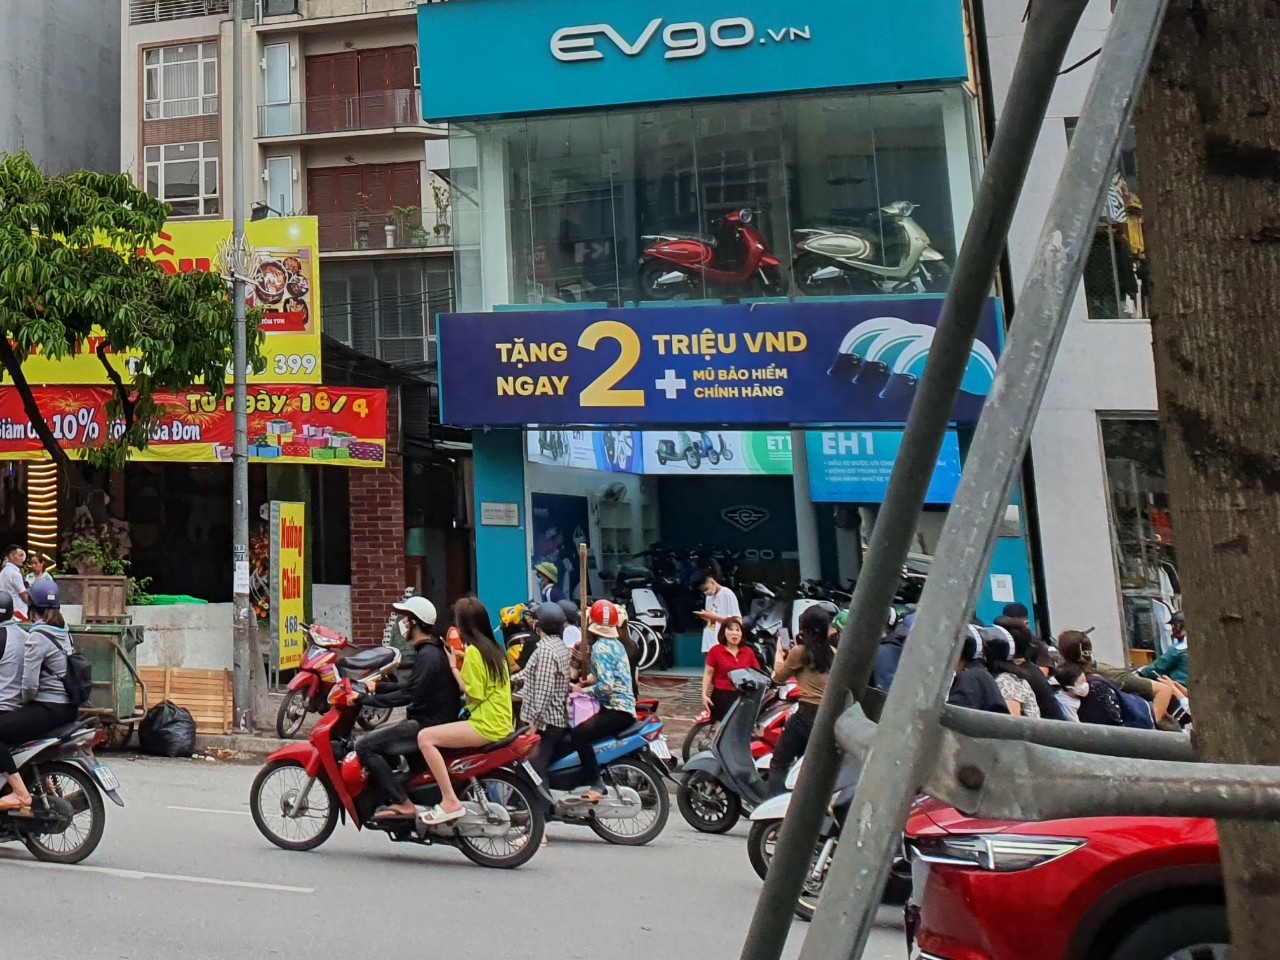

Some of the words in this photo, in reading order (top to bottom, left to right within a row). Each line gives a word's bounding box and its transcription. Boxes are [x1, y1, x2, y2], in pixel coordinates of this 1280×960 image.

[496, 337, 568, 368] TẶNG
[652, 327, 737, 361] TRIỆU
[743, 330, 808, 354] VND
[273, 353, 317, 375] 399
[577, 320, 646, 407] 2
[693, 367, 715, 381] MŨ
[718, 365, 749, 381] BẢO
[751, 363, 788, 380] HIỂM
[496, 375, 570, 396] NGAY
[693, 383, 739, 399] CHÍNH
[741, 383, 784, 398] HÃNG
[52, 407, 99, 443] 10%
[172, 420, 201, 441] Đơn
[822, 431, 875, 456] EH1
[284, 615, 298, 634] 468
